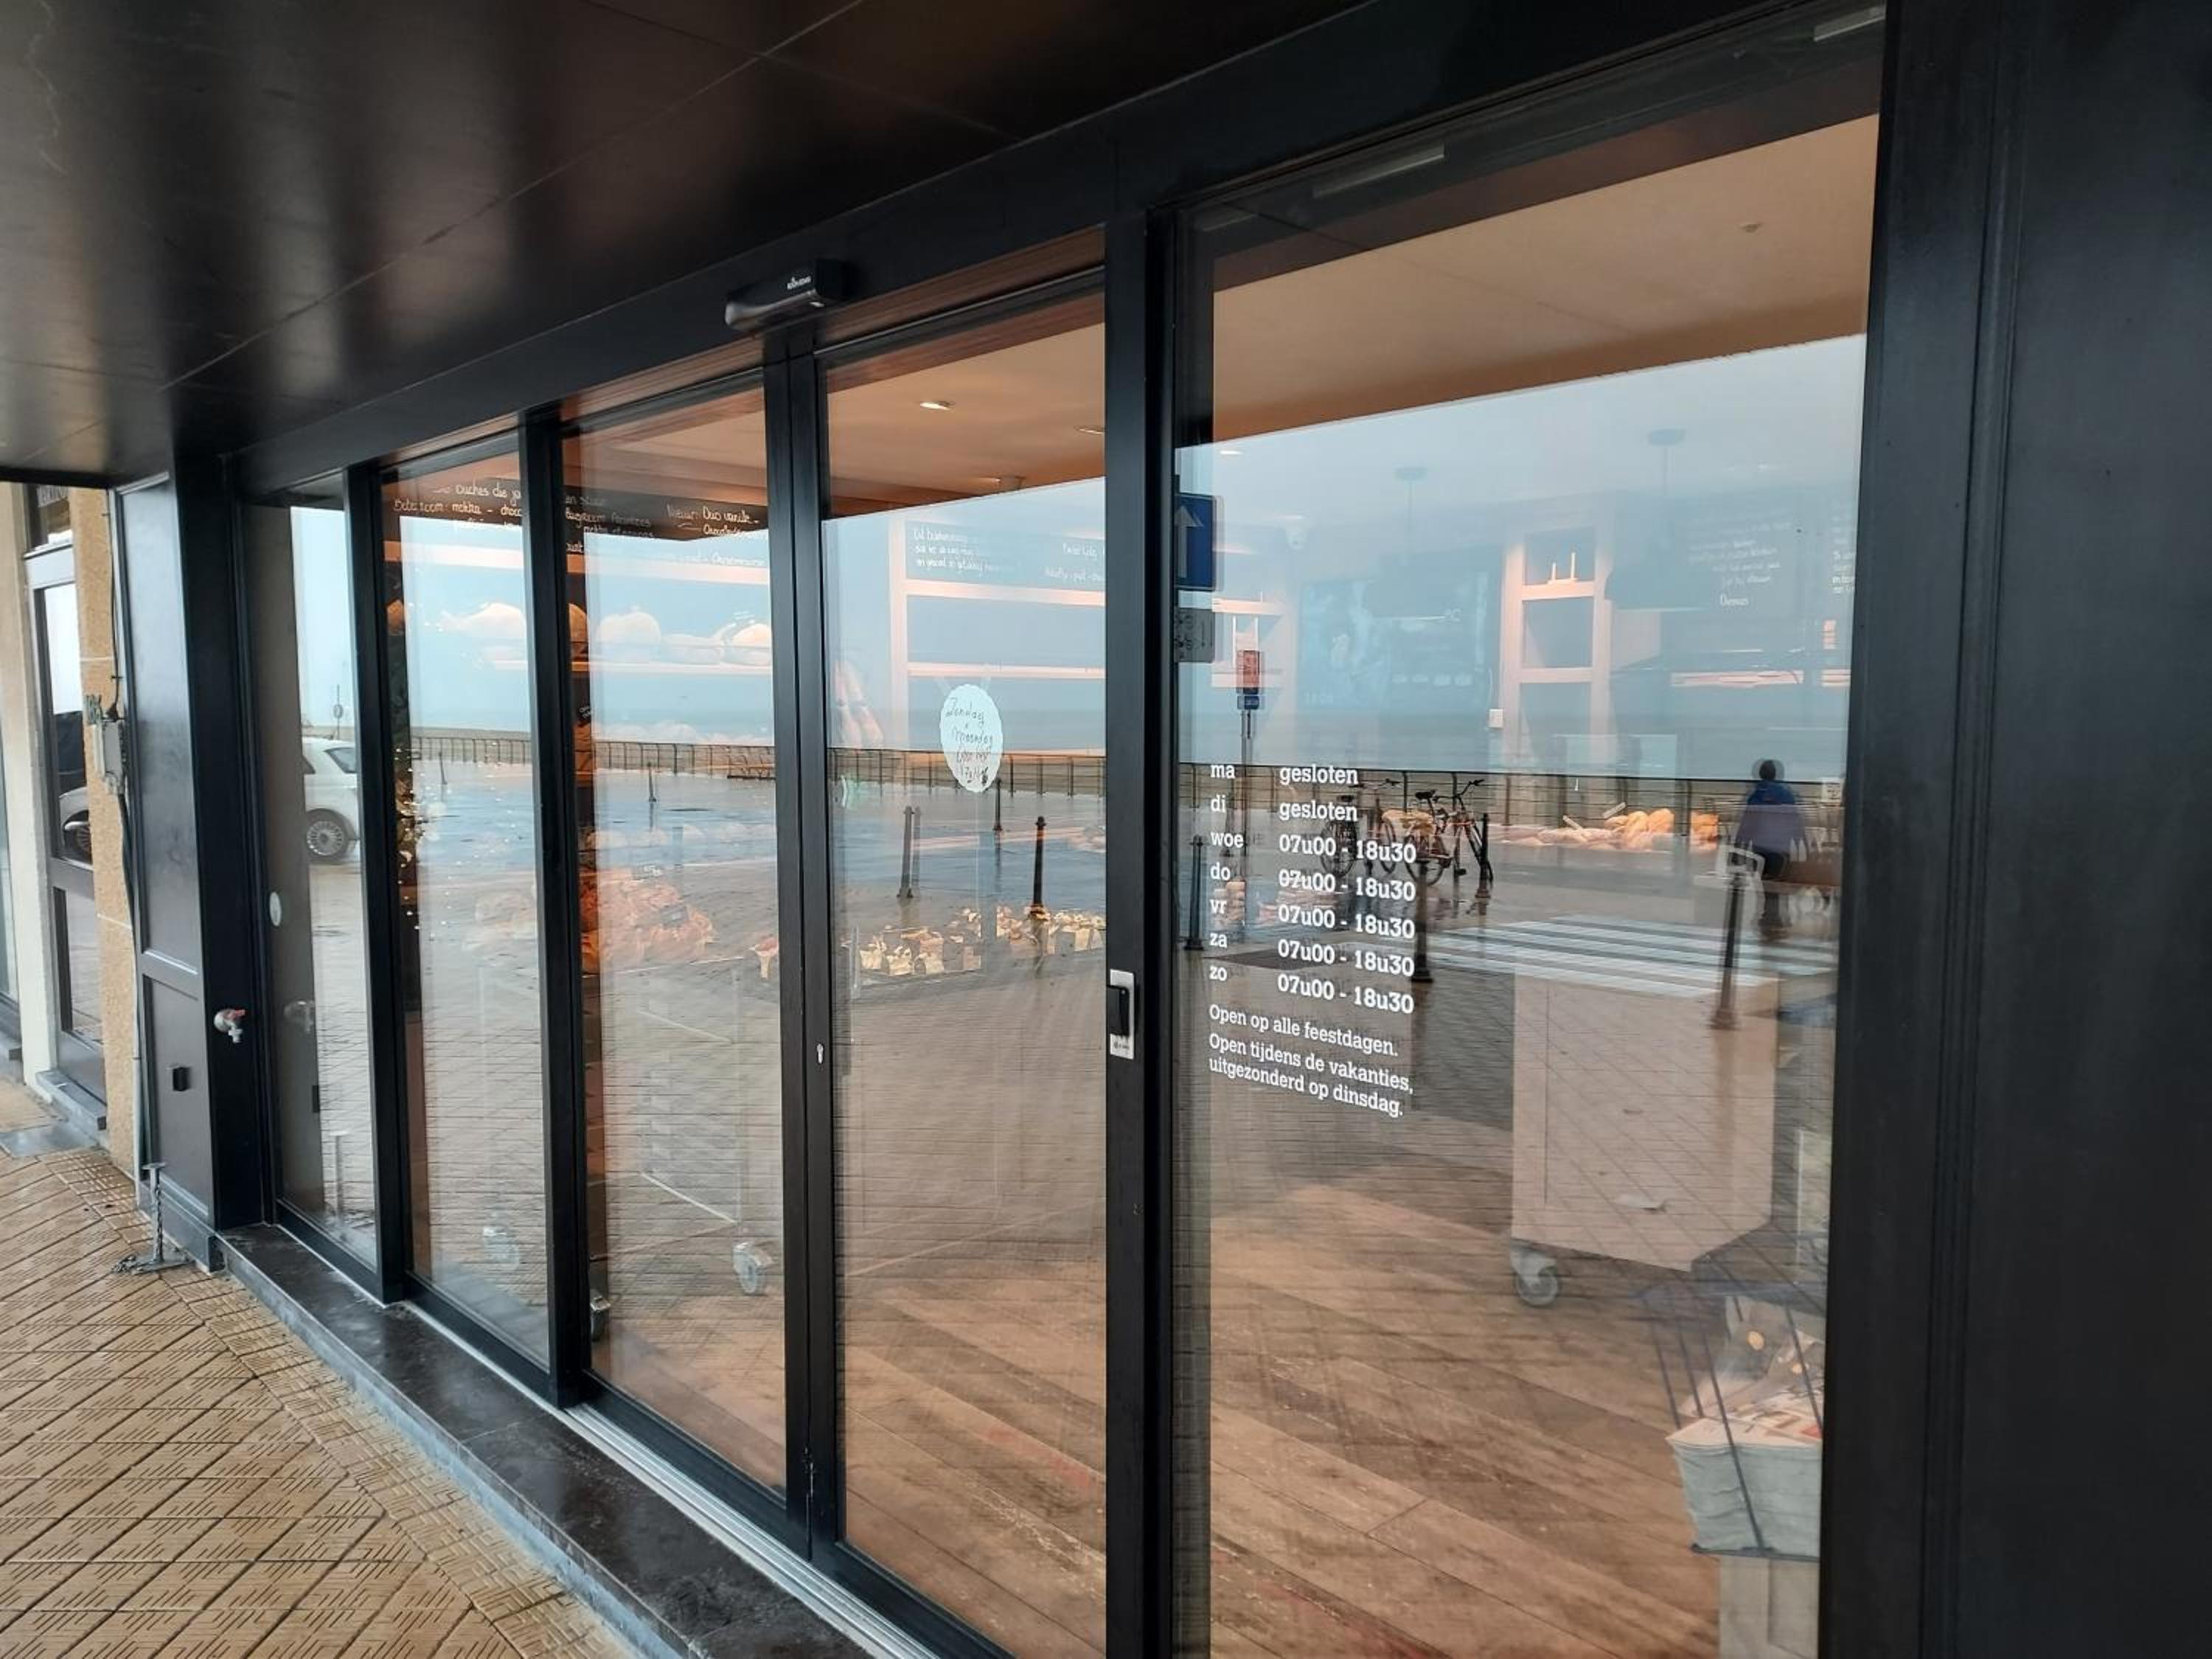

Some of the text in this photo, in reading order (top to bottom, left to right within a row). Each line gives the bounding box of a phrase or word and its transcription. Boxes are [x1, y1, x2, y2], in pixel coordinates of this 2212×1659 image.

[1210, 764, 1359, 785] ma gesloten
[1210, 794, 1358, 822] di gesloten
[1210, 831, 1244, 849] woe
[1279, 834, 1337, 857] 07u00
[1356, 839, 1416, 863] 18u30
[1210, 861, 1231, 881] do
[1279, 869, 1336, 893] 07u00
[1356, 877, 1416, 902] 18u30
[1209, 899, 1228, 914] vr
[1278, 903, 1335, 928] 07u00
[1355, 913, 1415, 939] 18u30
[1209, 932, 1228, 948] za
[1278, 939, 1335, 964] 07u00
[1354, 950, 1415, 977] 18u30
[1209, 965, 1228, 981] zo
[1278, 973, 1335, 1001] 07u00
[1354, 986, 1414, 1014] 18u30
[1209, 1004, 1398, 1057] Open op alle feestdagen.
[1209, 1032, 1413, 1096] Open tijdens de vakanties,
[1208, 1057, 1404, 1117] uitgezonderd op dinsdag.
